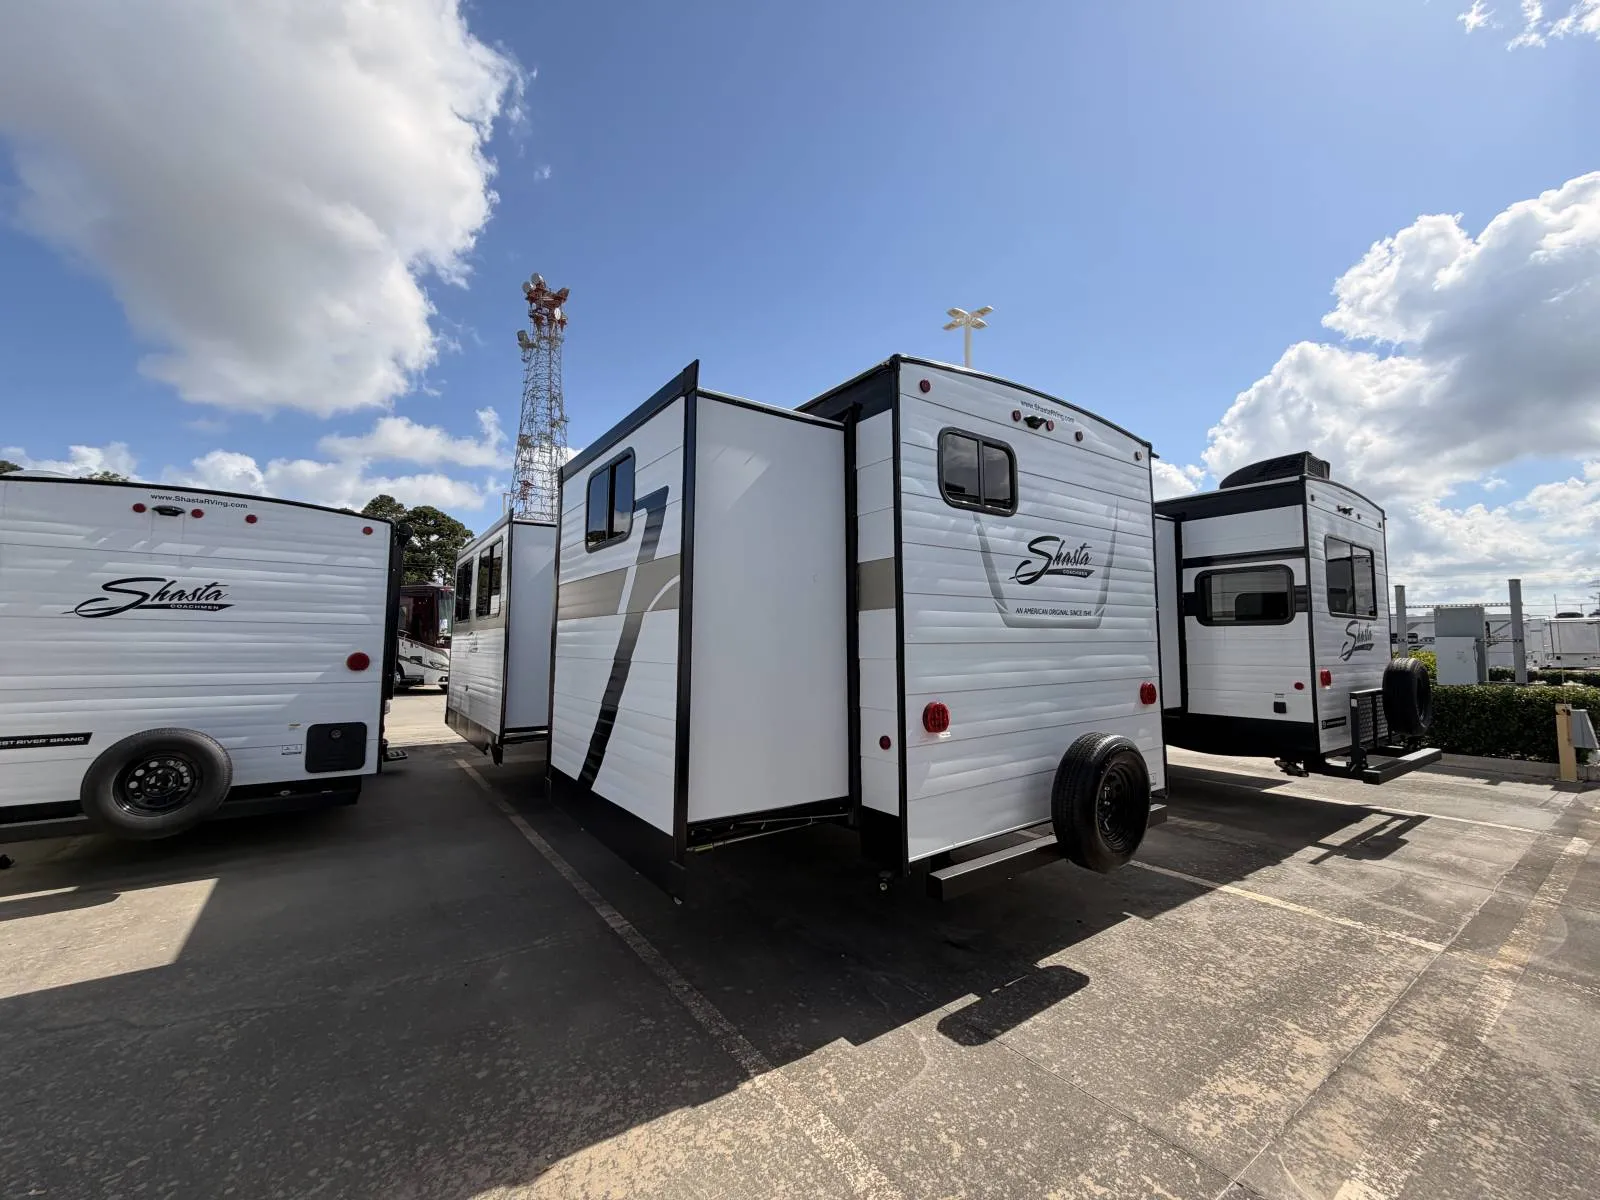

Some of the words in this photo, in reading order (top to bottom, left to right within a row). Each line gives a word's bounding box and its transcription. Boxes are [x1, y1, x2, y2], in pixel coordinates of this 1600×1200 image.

[1020, 400, 1075, 423] www.ShastaRVing.com
[150, 494, 248, 509] www.ShastaRVing.com
[1015, 535, 1092, 585] Shasta
[74, 577, 230, 618] Shasta
[170, 603, 219, 611] COACHMEN
[1049, 608, 1069, 616] ORIGINAL
[1070, 609, 1082, 617] SINCE
[1341, 620, 1373, 661] Shasta
